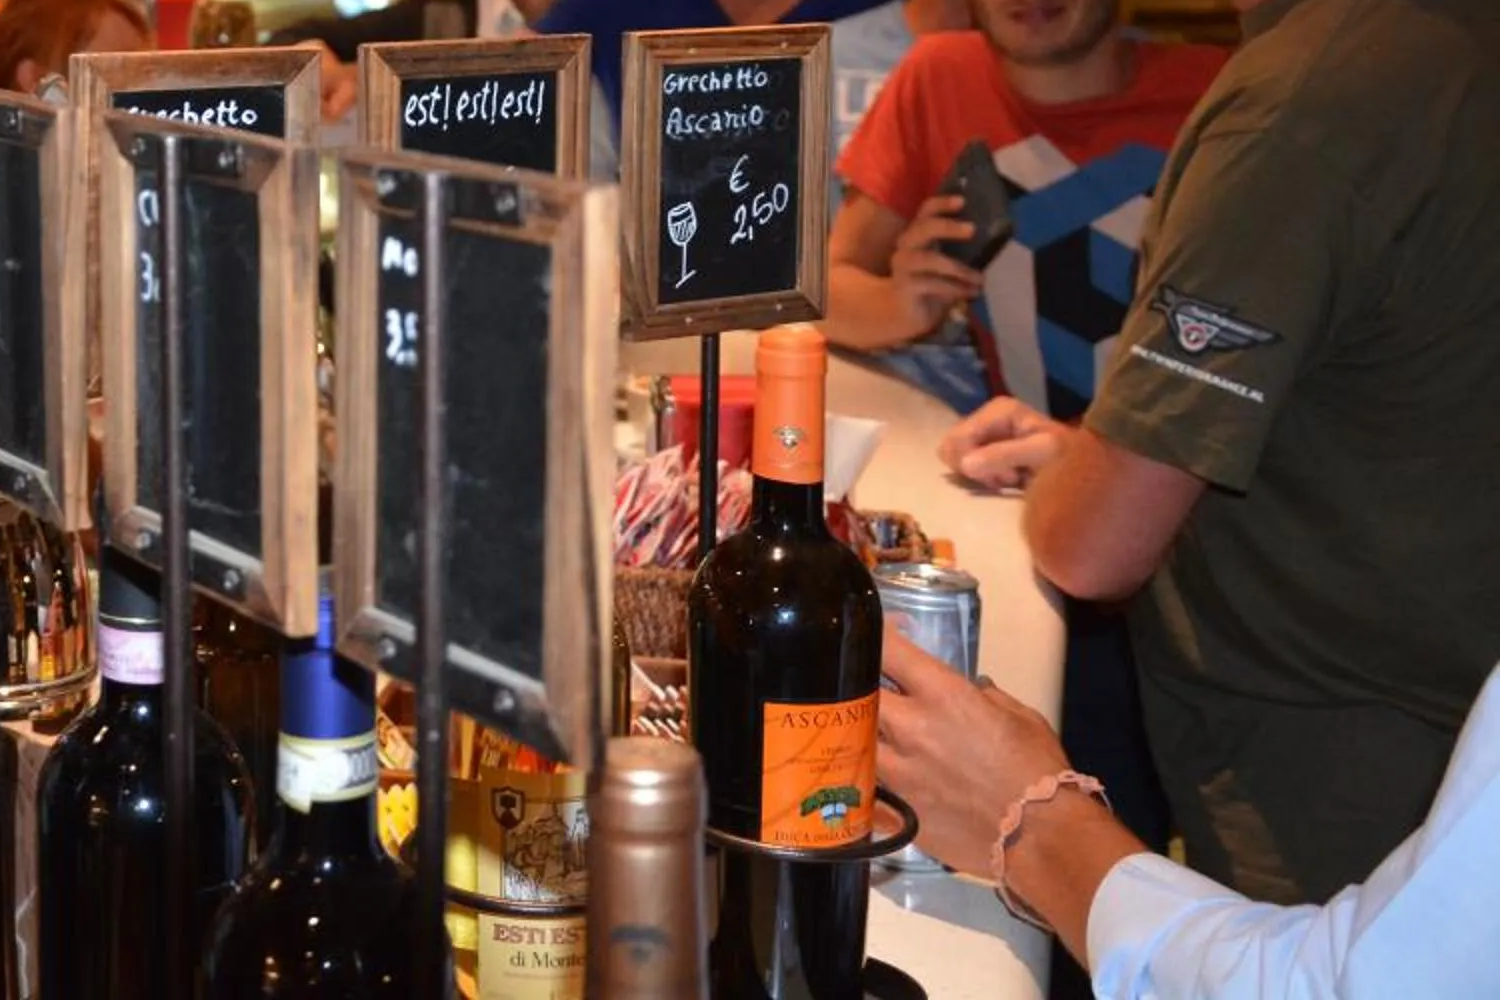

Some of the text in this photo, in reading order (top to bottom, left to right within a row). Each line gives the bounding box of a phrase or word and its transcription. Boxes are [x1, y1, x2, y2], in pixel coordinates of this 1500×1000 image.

[664, 67, 768, 95] Grechetto
[666, 104, 764, 135] Ascanio
[730, 183, 789, 245] 2,50
